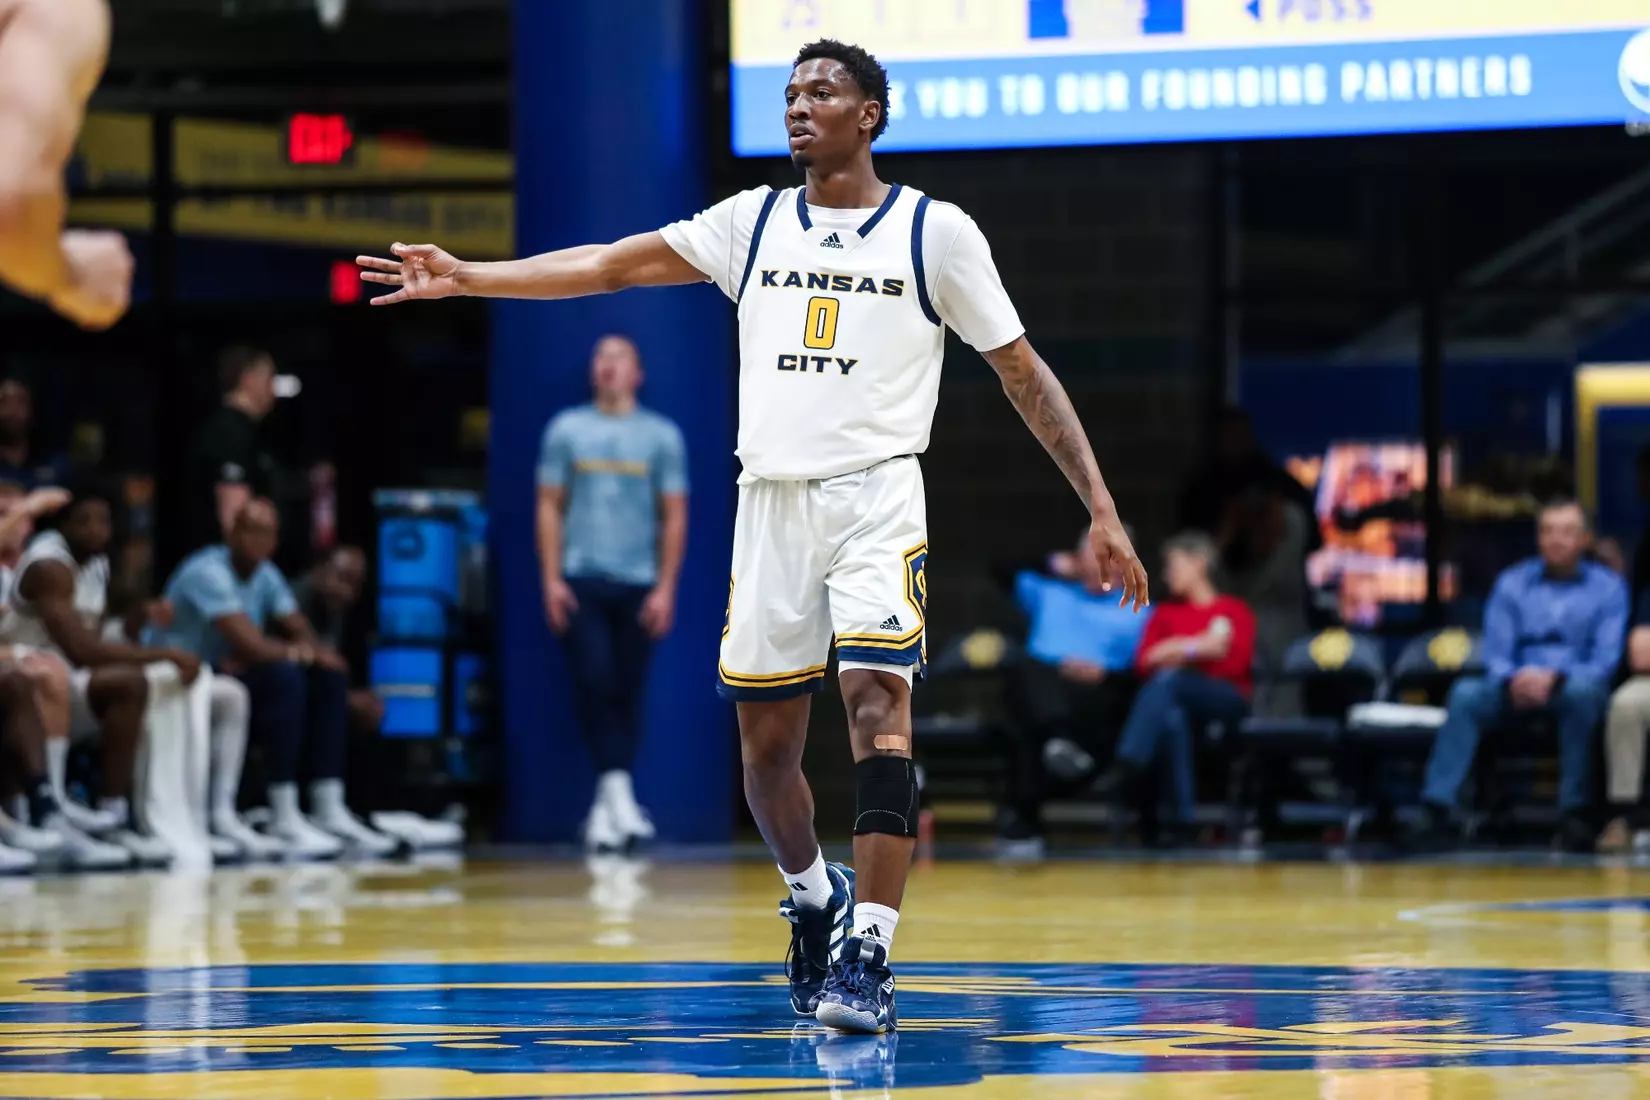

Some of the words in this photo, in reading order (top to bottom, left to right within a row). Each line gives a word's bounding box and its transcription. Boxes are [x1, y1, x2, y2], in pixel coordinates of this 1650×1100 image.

[915, 77, 989, 119] YOU
[997, 73, 1045, 117] TO
[1055, 70, 1130, 115] OUR
[1140, 62, 1328, 112] FOUNDING
[1341, 54, 1531, 102] PARTNERS
[820, 240, 844, 249] adidas
[760, 269, 905, 297] KANSAS
[803, 296, 840, 350] 0
[777, 354, 859, 375] CITY
[880, 623, 902, 631] adidas
